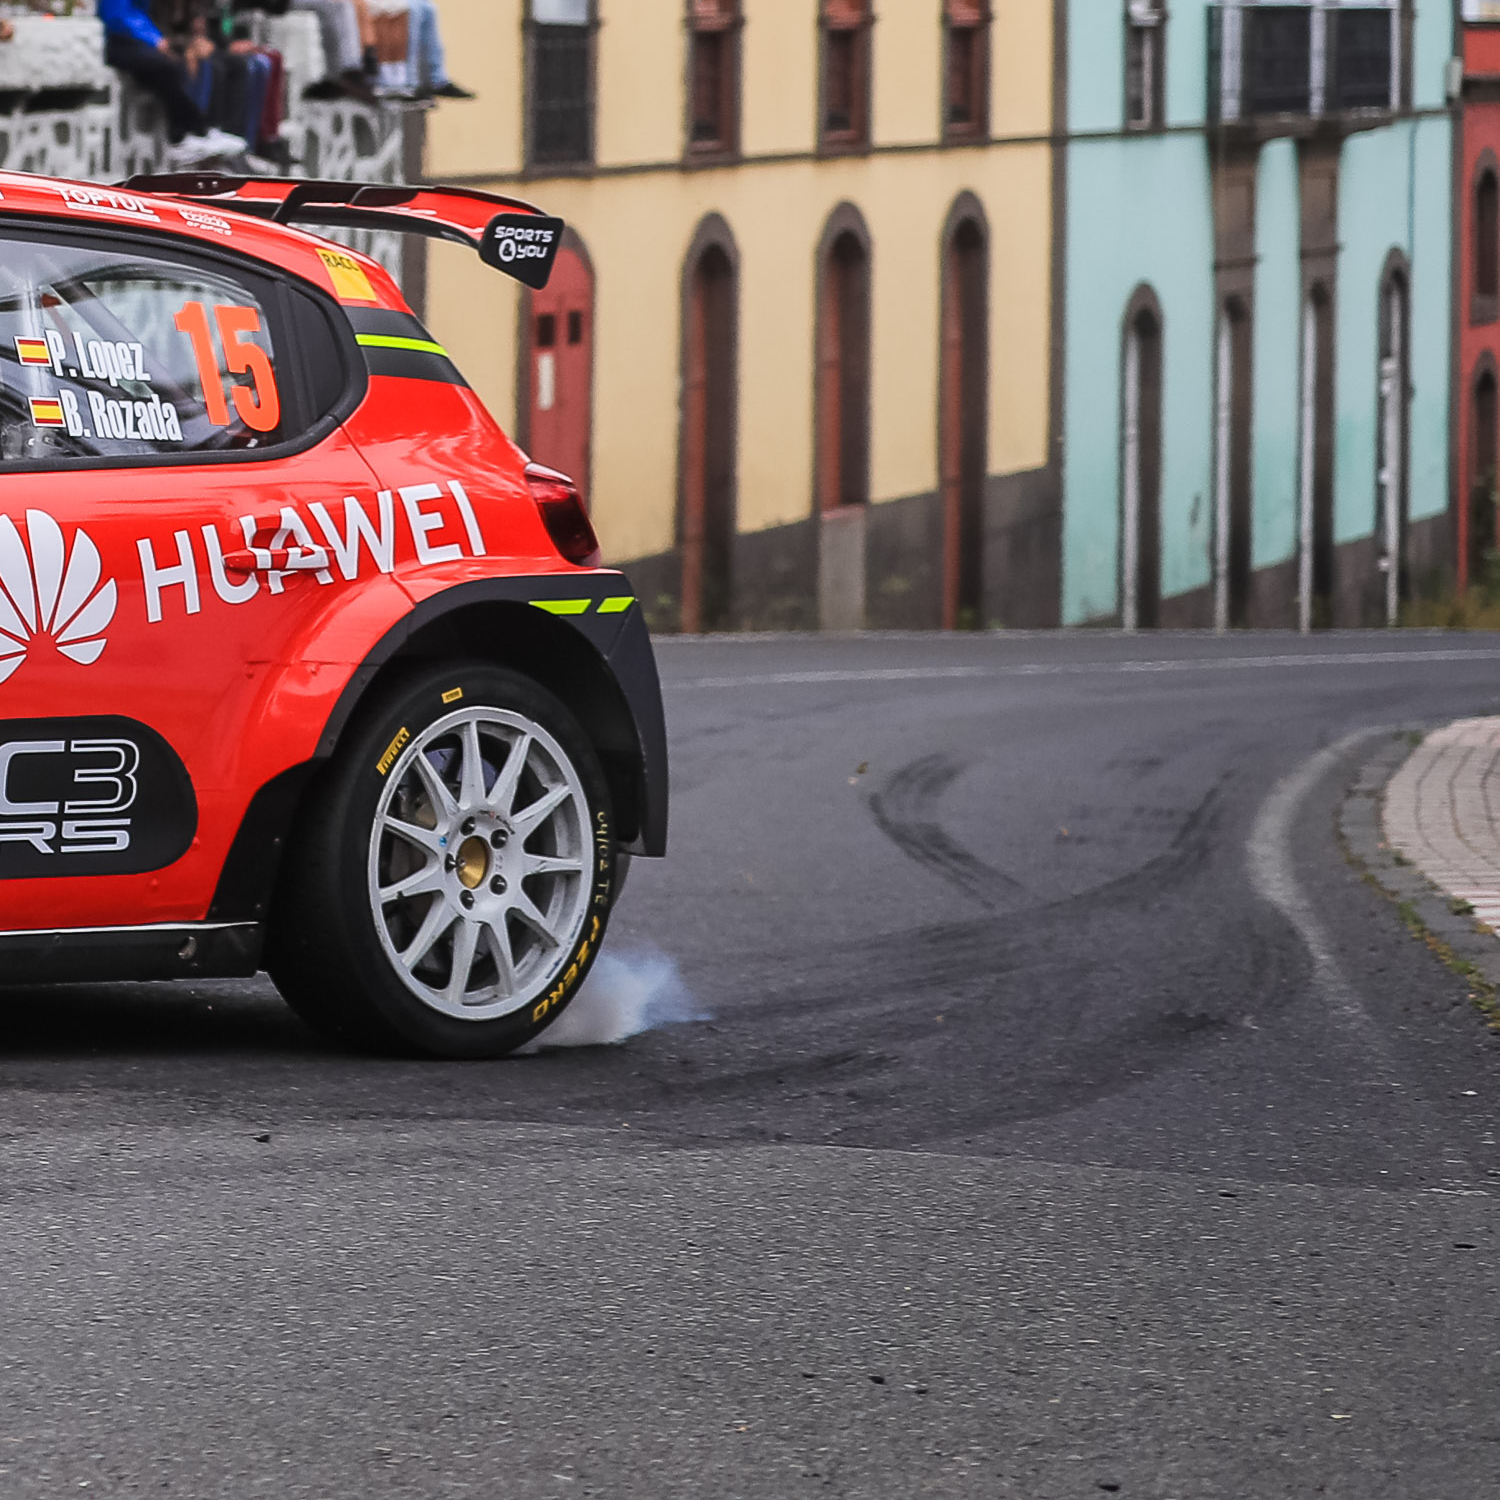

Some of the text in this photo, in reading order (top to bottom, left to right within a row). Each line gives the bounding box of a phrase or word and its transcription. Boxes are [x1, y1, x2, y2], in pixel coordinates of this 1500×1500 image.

[53, 187, 154, 214] TOPTUL
[495, 225, 554, 243] SPORTS
[45, 329, 152, 387] P. Lopez
[173, 300, 280, 432] 15
[59, 388, 184, 442] B. Rozada
[136, 479, 487, 623] HUAWEI
